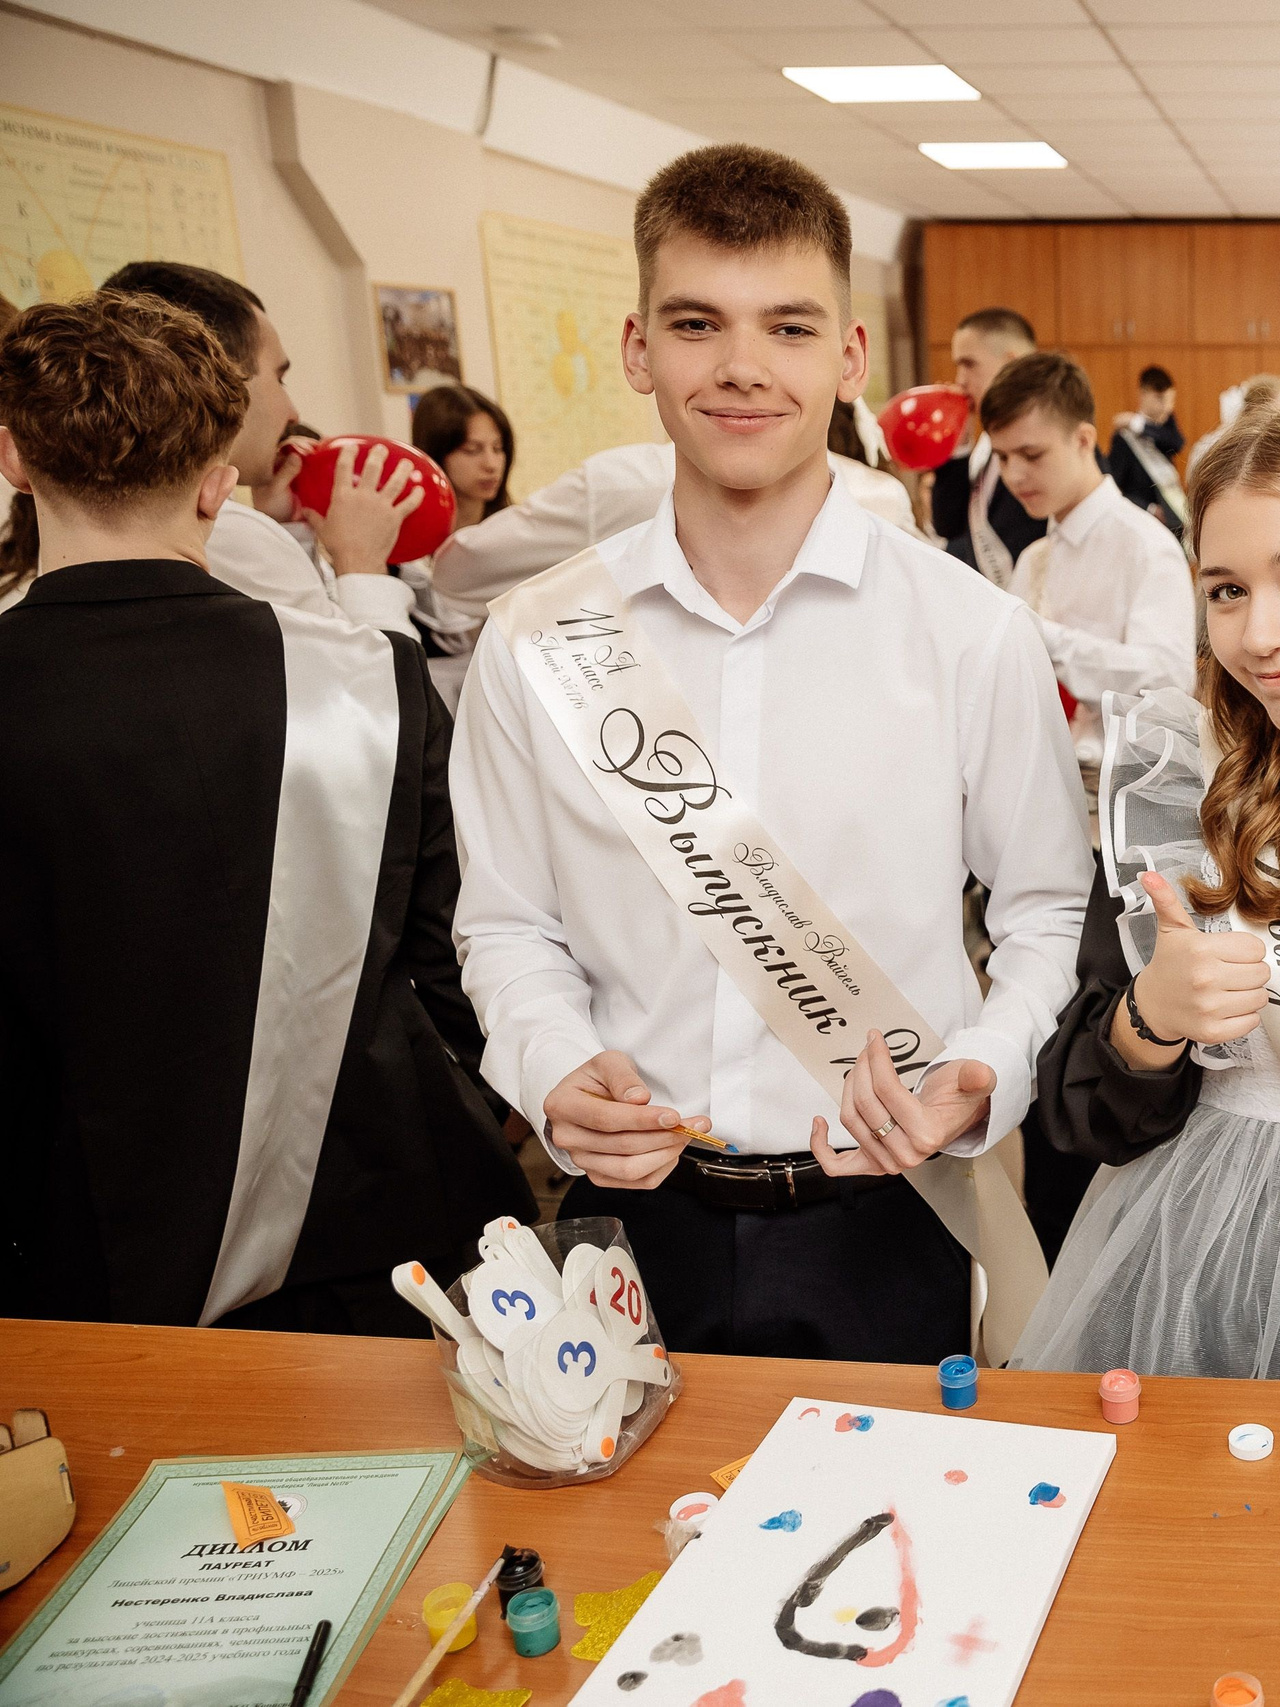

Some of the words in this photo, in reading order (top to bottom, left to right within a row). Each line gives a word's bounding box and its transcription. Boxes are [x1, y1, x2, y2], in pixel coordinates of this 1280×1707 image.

[530, 630, 564, 676] Лицей
[556, 609, 623, 641] 11
[594, 645, 640, 677] А
[571, 653, 604, 692] класс
[592, 708, 847, 1035] Выпускник
[733, 842, 812, 930] Владислав
[804, 931, 861, 997] Вайгель
[491, 1288, 536, 1321] 3
[609, 1266, 642, 1326] 20
[557, 1340, 596, 1378] 3
[199, 1560, 275, 1571] ЛАУРЕАТ
[107, 1577, 176, 1588] Лицейской
[111, 1596, 210, 1608] Нестеренко
[214, 1589, 313, 1602] Владислава
[83, 1633, 139, 1644] высокие
[140, 1629, 218, 1640] достижения
[232, 1623, 313, 1635] профильных
[133, 1619, 187, 1630] ученица
[218, 1615, 260, 1623] класса
[229, 1636, 312, 1647] чемпионатах
[54, 1659, 138, 1672] результатам
[140, 1652, 208, 1665] 2024-2025
[209, 1650, 271, 1663] учебного
[273, 1648, 302, 1657] года
